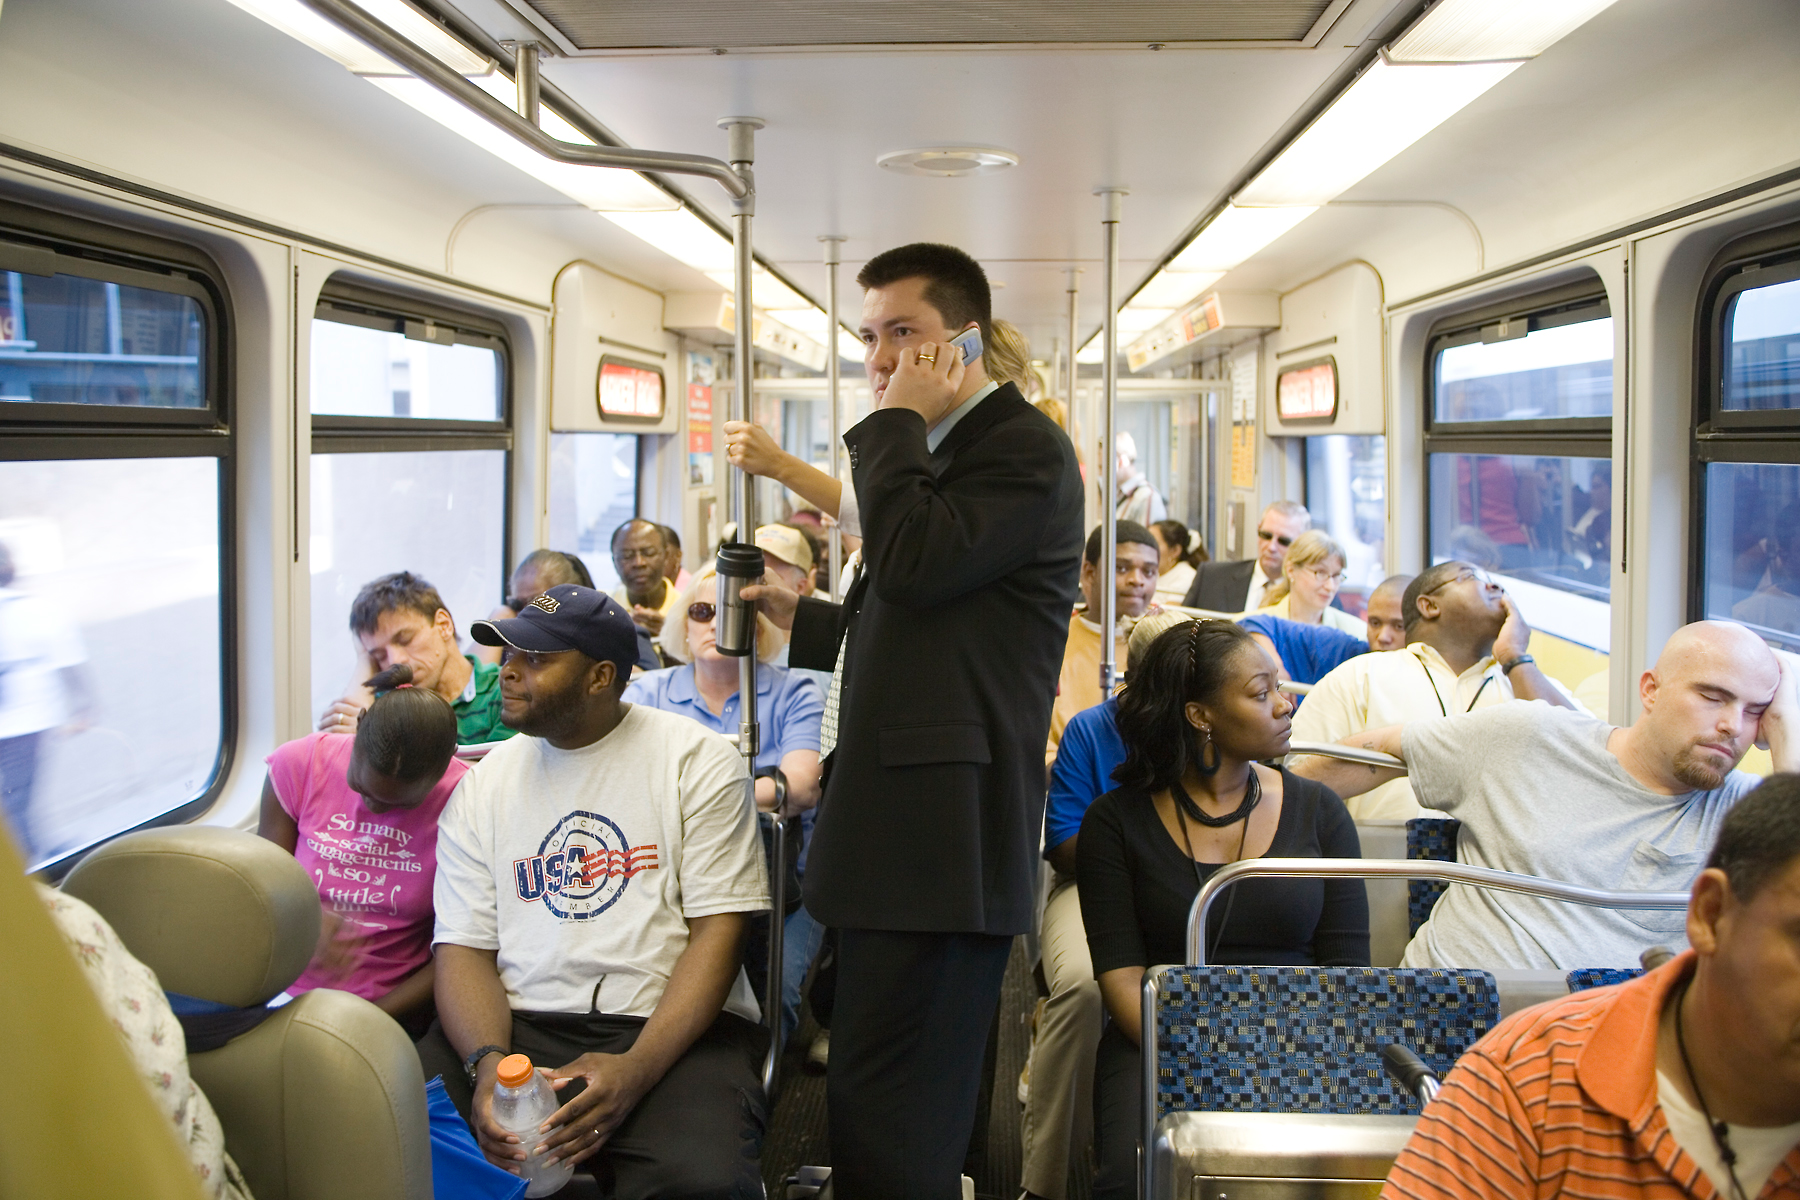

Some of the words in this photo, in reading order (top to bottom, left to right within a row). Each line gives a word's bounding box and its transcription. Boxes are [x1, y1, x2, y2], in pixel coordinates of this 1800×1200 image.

[327, 813, 355, 831] So
[357, 821, 413, 847] many
[552, 819, 612, 848] OFFICIAL
[306, 838, 422, 873] engagements
[339, 838, 389, 857] social
[513, 844, 594, 903] USA
[326, 887, 385, 905] little
